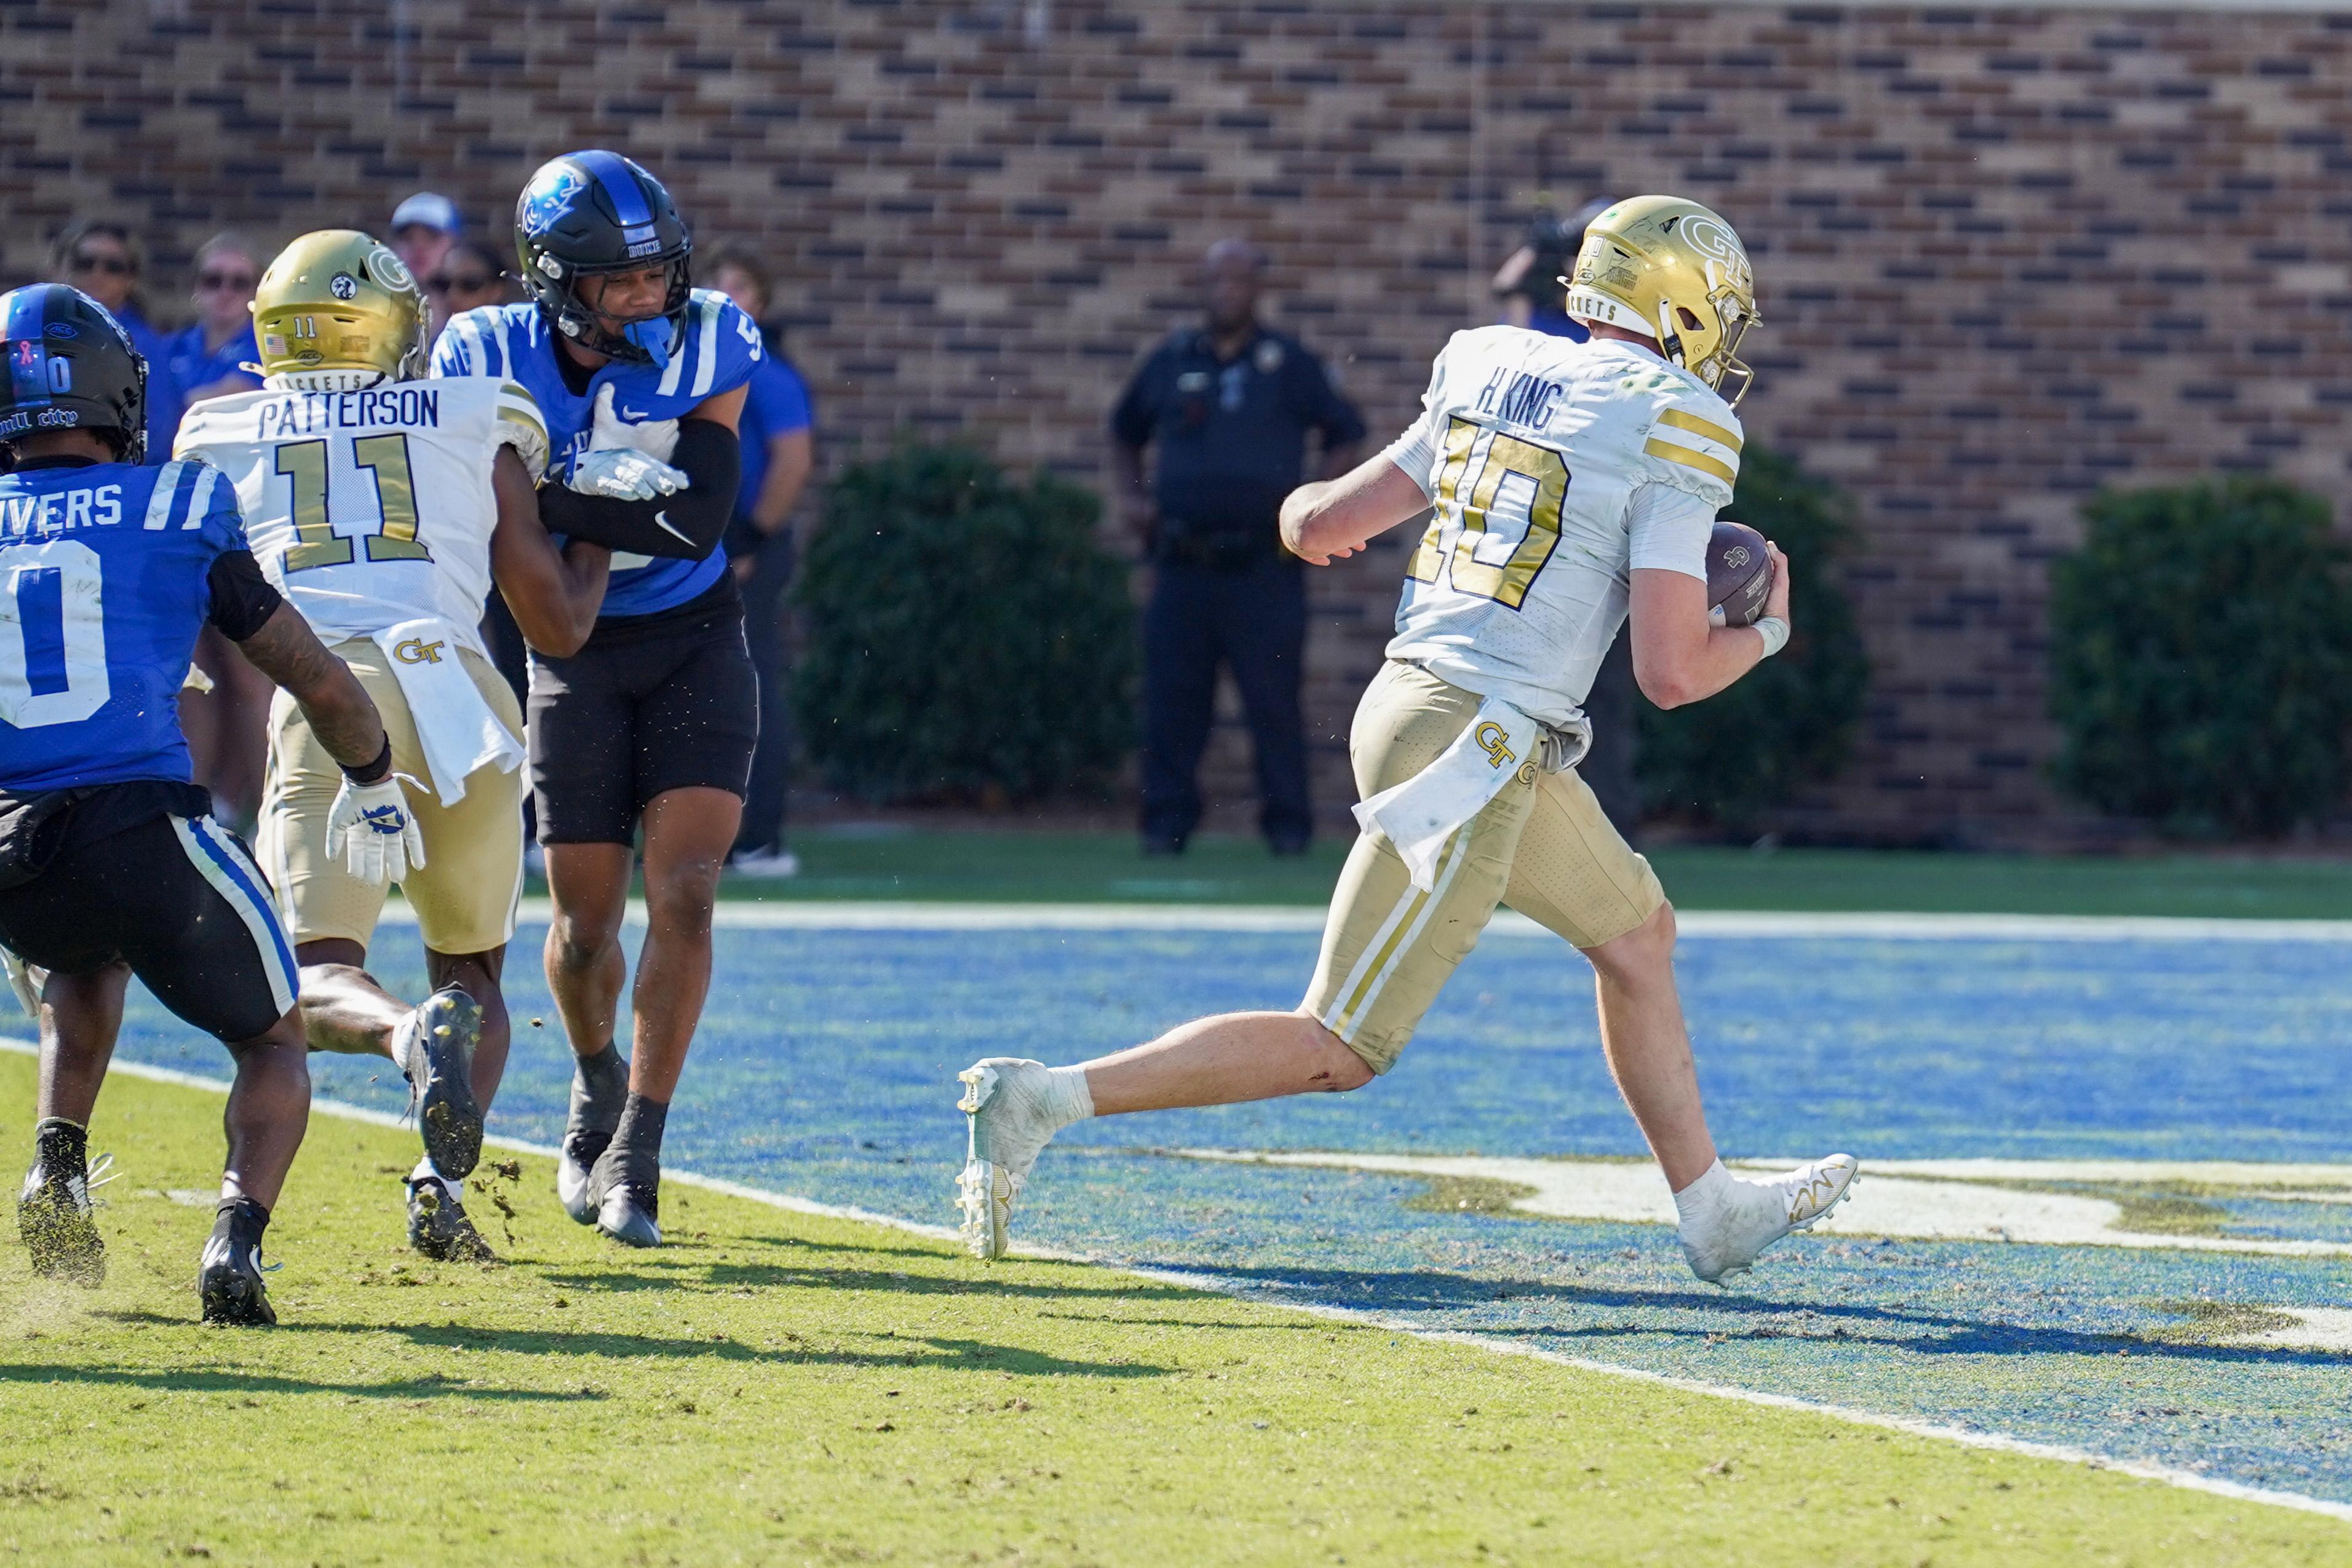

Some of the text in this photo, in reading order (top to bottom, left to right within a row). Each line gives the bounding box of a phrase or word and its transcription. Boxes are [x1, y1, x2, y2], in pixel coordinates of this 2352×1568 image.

[628, 239, 661, 258] DUKE
[294, 317, 316, 338] 11
[1566, 296, 1616, 321] CKETS
[49, 325, 74, 336] ACC
[736, 314, 762, 362] 5
[47, 356, 71, 394] 0
[38, 408, 78, 427] city
[259, 390, 438, 438] PATTERSON
[1476, 366, 1563, 430] H.KING
[274, 433, 435, 574] 11
[1404, 414, 1572, 612] 10
[0, 539, 111, 729] 0
[394, 638, 445, 664] GT
[1475, 721, 1516, 769] GT
